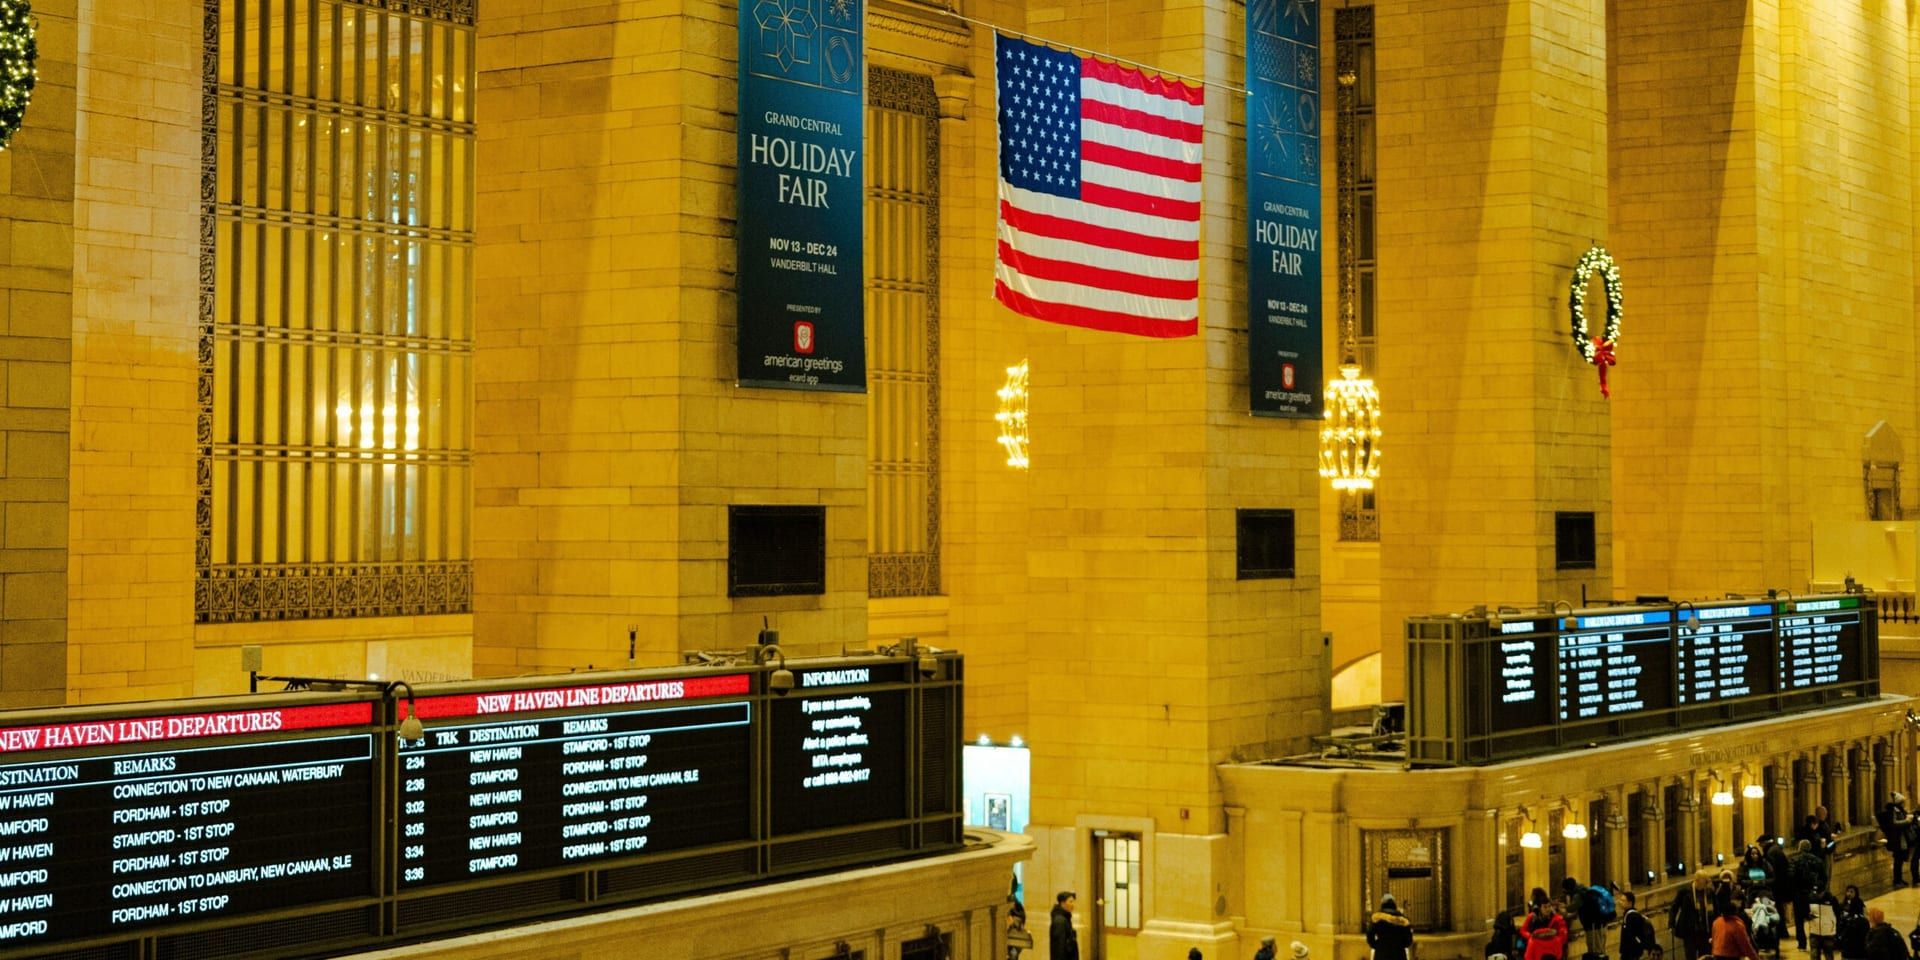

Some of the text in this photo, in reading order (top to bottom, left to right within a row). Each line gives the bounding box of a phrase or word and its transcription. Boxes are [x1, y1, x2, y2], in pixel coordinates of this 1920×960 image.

[765, 111, 843, 136] GRAND CENTRAL
[751, 134, 856, 178] HOLIDAY
[778, 174, 830, 209] FAIR
[1264, 201, 1310, 219] GRAND CENTRAL
[770, 238, 790, 251] NOV
[791, 241, 800, 253] 13
[807, 242, 825, 256] DEC
[826, 245, 838, 257] 24
[1256, 219, 1318, 251] HOLIDAY
[770, 258, 837, 275] VANDERBILT HALL
[1272, 249, 1303, 276] FAIR
[787, 304, 814, 313] PRESENTED
[764, 354, 843, 374] american greetings
[789, 373, 819, 385] ecard app
[802, 668, 870, 687] INFORMATION
[476, 681, 684, 714] NEW HAVEN LINE DEPARTURES
[0, 711, 282, 751] NEW HAVEN LINE DEPARTURES
[435, 731, 459, 745] TRK
[469, 724, 539, 743] DESTINATION
[563, 718, 608, 735] REMARKS
[406, 756, 425, 770] 2:34
[470, 751, 491, 764] NEW
[492, 747, 522, 760] HAVEN
[563, 739, 608, 755] STAMFORD
[613, 736, 629, 750] 1ST
[629, 735, 651, 748] STOP
[812, 754, 829, 768] MTA
[0, 756, 176, 786] STINATION REMARKS
[406, 778, 425, 792] 2:36
[470, 768, 518, 785] STAMFORD
[563, 760, 604, 775] FORDHAM
[609, 757, 625, 771] 1ST
[625, 755, 648, 769] STOP
[812, 773, 825, 787] call
[13, 792, 54, 809] HAVEN
[113, 778, 188, 799] CONNECTION
[190, 777, 206, 792] TO
[207, 775, 233, 790] NEW
[234, 770, 280, 787] CANAAN,
[282, 764, 344, 783] WATERBURY
[405, 801, 424, 814] 3:02
[470, 793, 491, 807] NEW
[492, 789, 522, 804] HAVEN
[563, 779, 617, 796] CONNECTION
[618, 777, 630, 789] TO
[630, 775, 649, 788] NEW
[683, 769, 699, 782] SLE
[113, 805, 170, 824] FORDHAM
[179, 802, 200, 816] 1ST
[201, 799, 230, 815] STOP
[405, 823, 424, 837] 3:05
[469, 811, 518, 829] STAMFORD
[563, 801, 604, 817] FORDHAM
[609, 798, 625, 811] 1ST
[625, 796, 647, 809] STOP
[12, 842, 53, 860] HAVEN
[113, 830, 175, 849] STAMFORD
[184, 826, 204, 840] 1ST
[205, 822, 235, 838] STOP
[405, 845, 424, 859] 3:34
[469, 836, 491, 850] NEW
[492, 832, 521, 847] HAVEN
[563, 821, 608, 838] STAMFORD
[613, 818, 629, 832] 1ST
[629, 815, 651, 829] STOP
[112, 854, 170, 874] FORDHAM
[178, 851, 199, 865] 1ST
[200, 847, 230, 863] STOP
[404, 867, 424, 882] 3:36
[469, 854, 518, 872] STAMFORD
[563, 842, 604, 859] FORDHAM
[609, 838, 625, 853] 1ST
[625, 836, 647, 850] STOP
[12, 893, 53, 912] HAVEN
[112, 876, 187, 899] CONNECTION
[188, 873, 204, 888] TO
[206, 867, 259, 886] DANBURY,
[260, 863, 286, 879] NEW
[286, 858, 331, 875] CANAAN,
[332, 855, 352, 870] SLE
[112, 903, 169, 924] FORDHAM
[177, 899, 198, 914] 1ST
[200, 895, 229, 912] STOP
